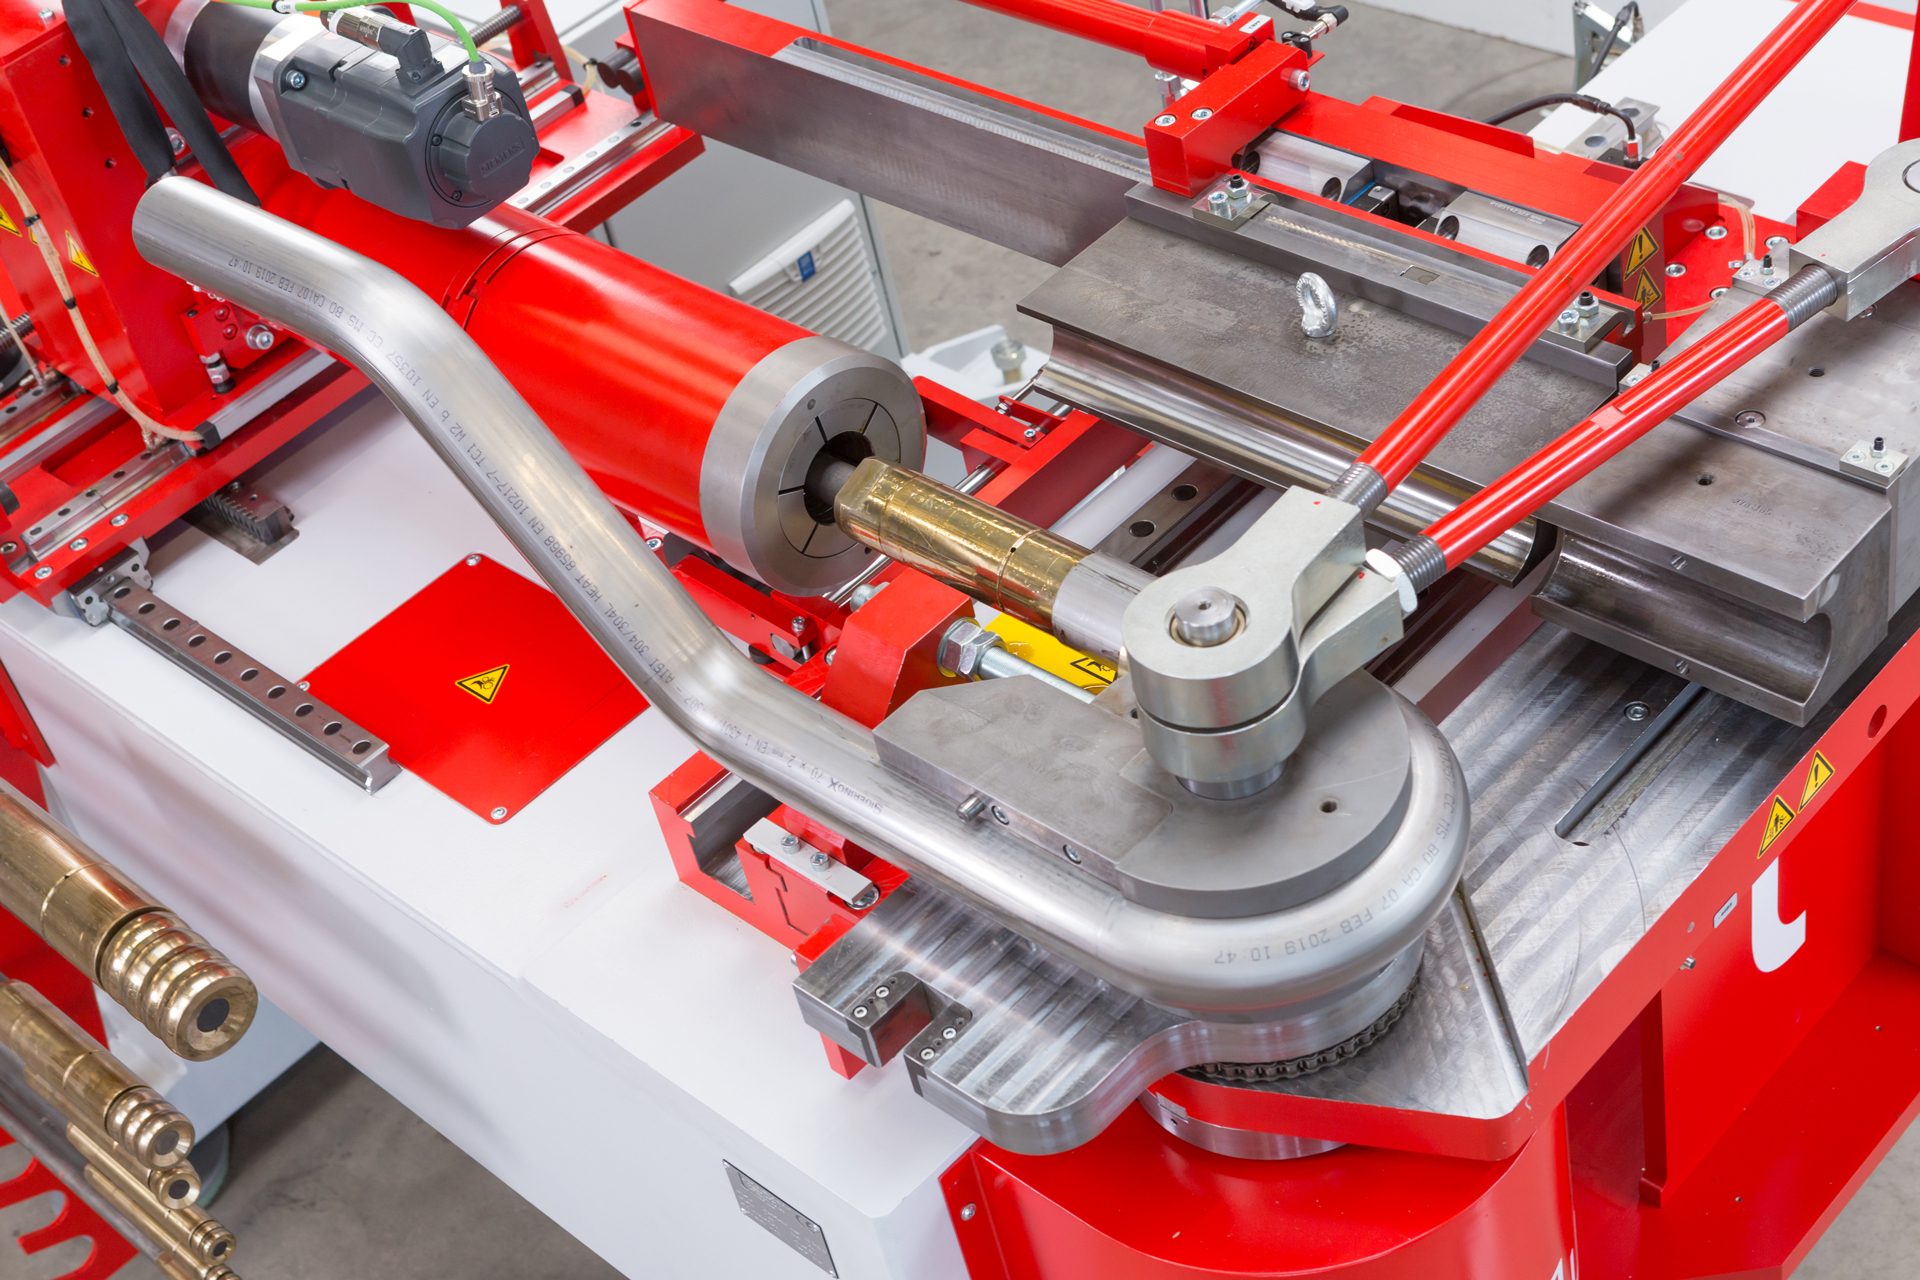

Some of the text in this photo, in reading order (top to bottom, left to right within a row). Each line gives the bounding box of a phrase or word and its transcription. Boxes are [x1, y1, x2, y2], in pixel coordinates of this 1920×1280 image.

[482, 141, 523, 173] SIEMENS
[228, 254, 253, 274] 10:47
[255, 266, 276, 284] 2019
[277, 276, 295, 293] FEB
[296, 285, 310, 300] 07
[312, 292, 326, 308] CA
[346, 314, 364, 332] MS
[366, 329, 384, 348] CC
[385, 350, 422, 386] 10357
[422, 388, 440, 409] EN
[449, 422, 466, 442] W2
[466, 442, 486, 467] TC1
[486, 469, 528, 515] 10217-7
[526, 516, 544, 534] EN
[543, 535, 576, 572] 85968
[574, 574, 603, 602] HEAT
[602, 602, 650, 657] 304/304L
[648, 657, 675, 684] AISI
[754, 738, 768, 754] EN
[786, 754, 796, 768] 2
[810, 766, 824, 784] 70
[1443, 792, 1456, 814] CC
[1434, 816, 1450, 840] MS
[1401, 866, 1422, 887] CA
[1380, 888, 1399, 910] 07
[1338, 907, 1373, 934] FEB
[1284, 928, 1331, 956] 2019
[1214, 945, 1272, 965] 10:47
